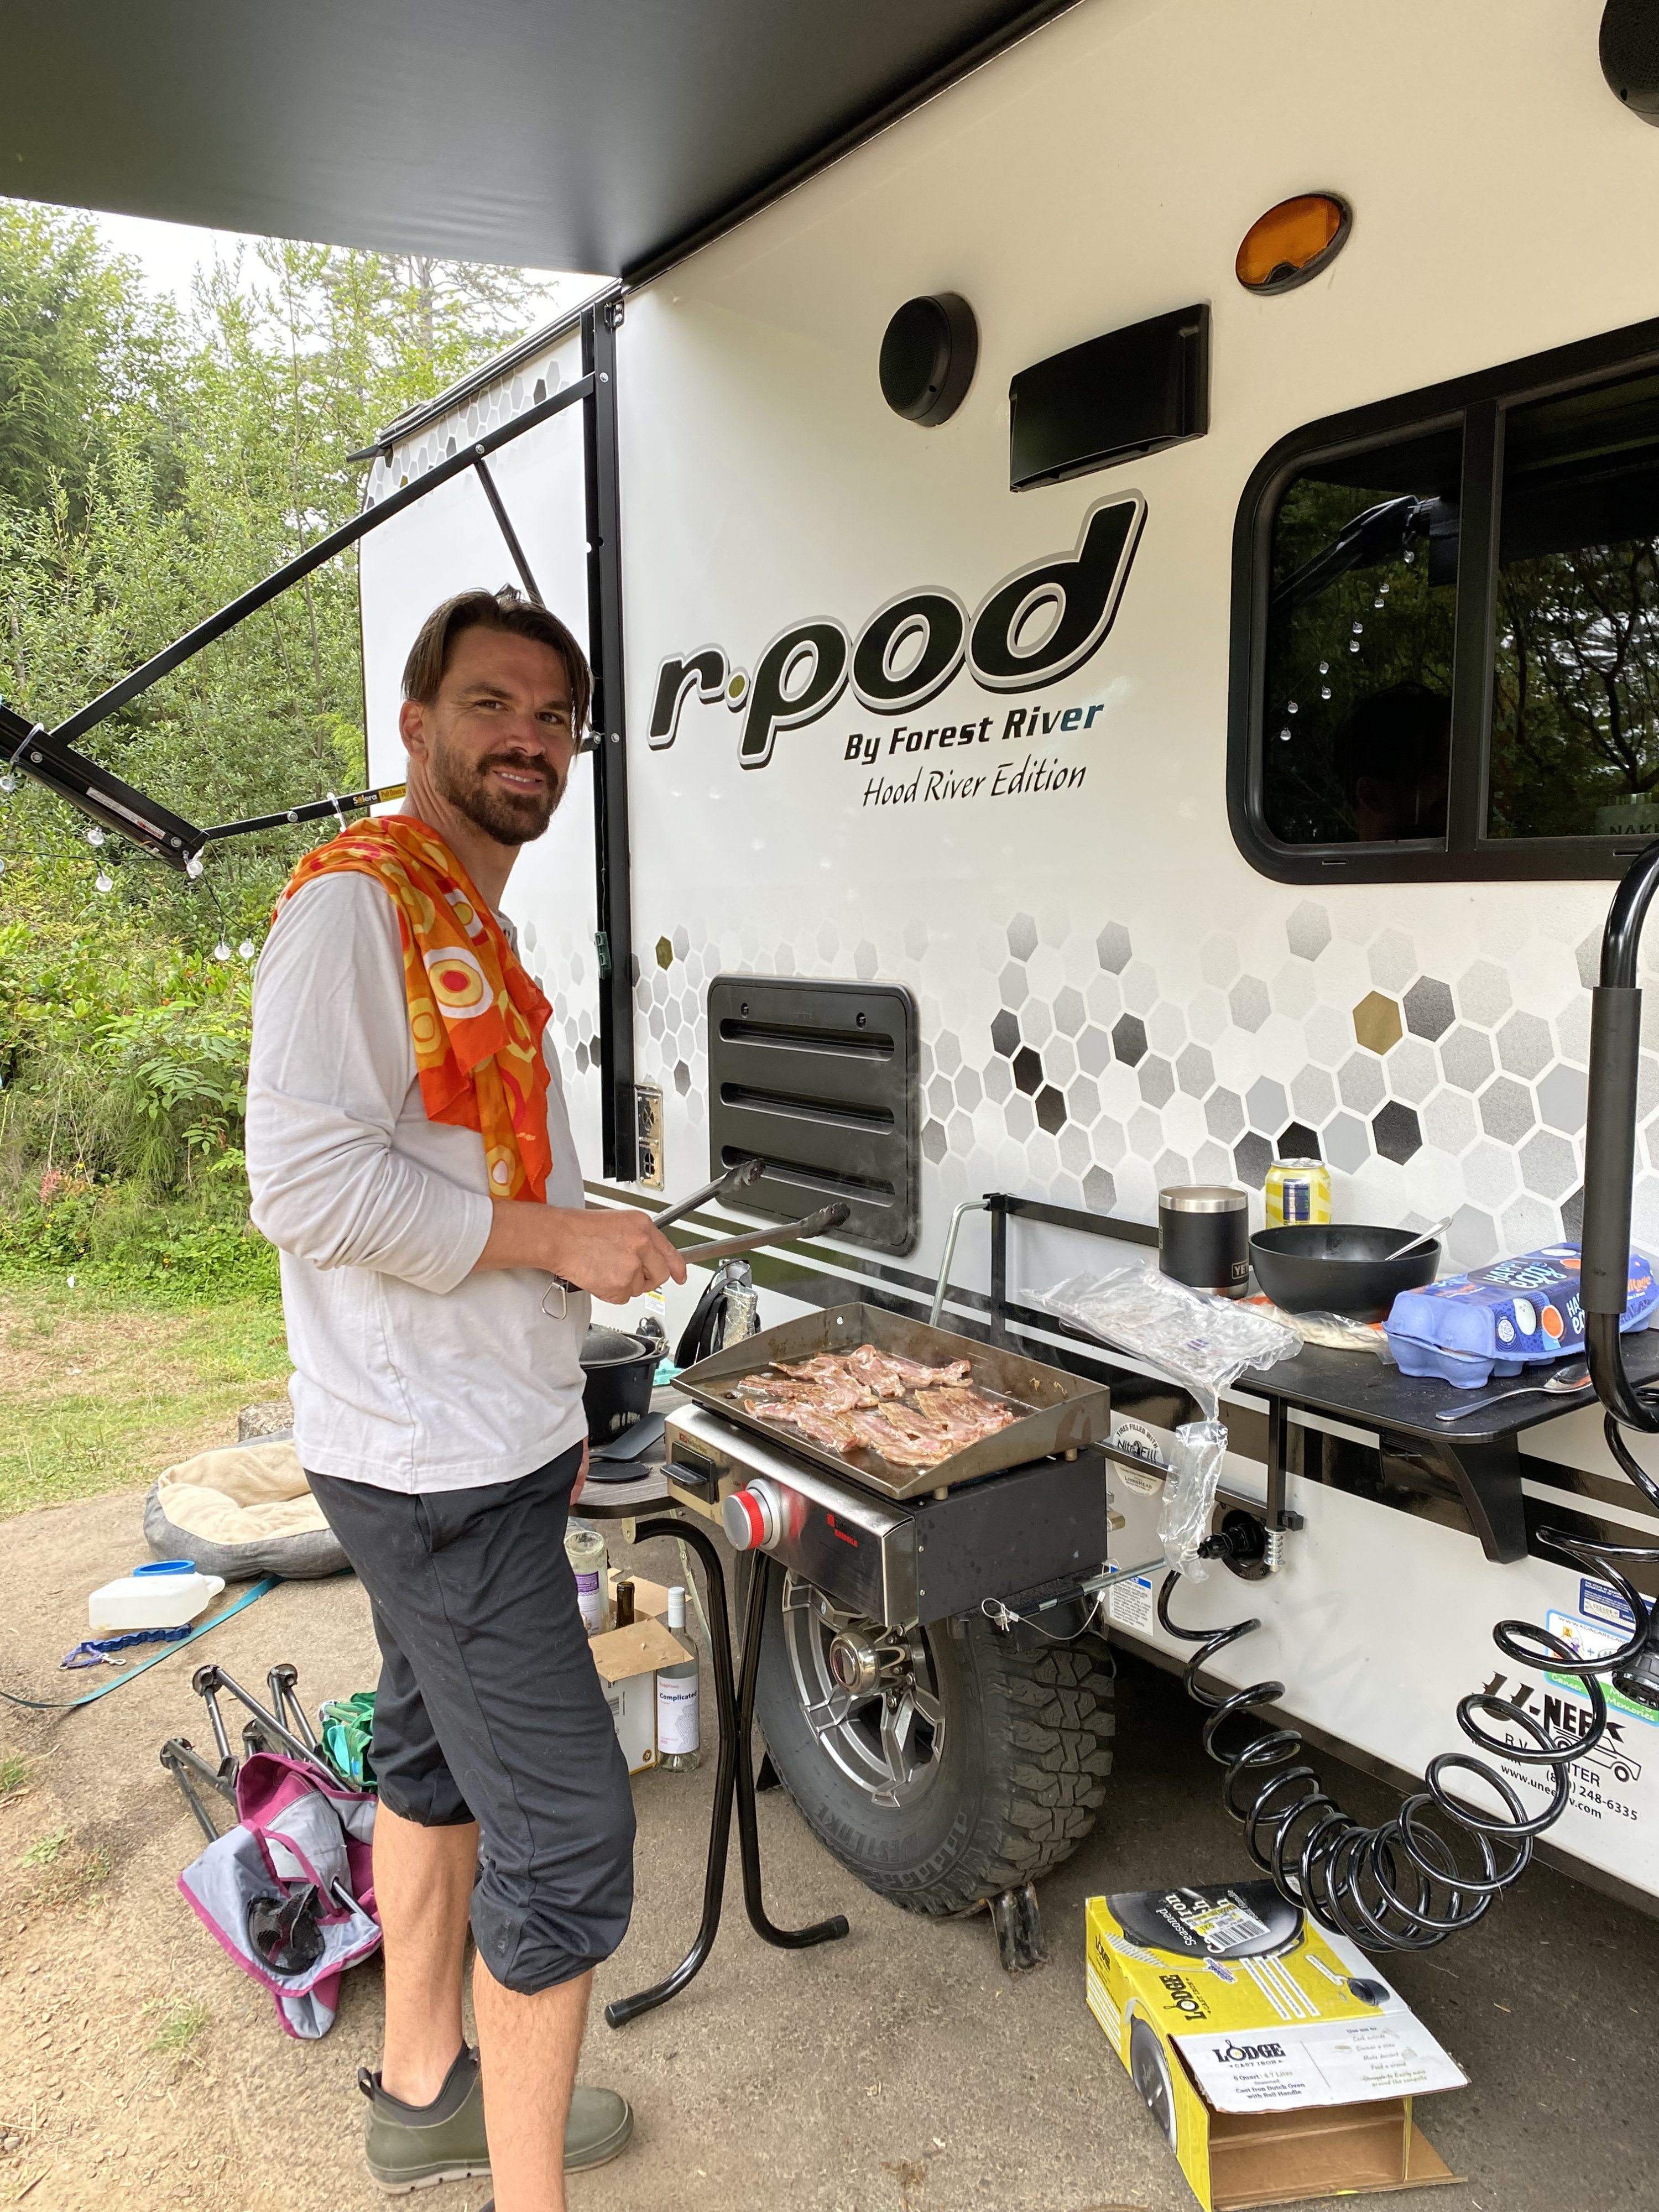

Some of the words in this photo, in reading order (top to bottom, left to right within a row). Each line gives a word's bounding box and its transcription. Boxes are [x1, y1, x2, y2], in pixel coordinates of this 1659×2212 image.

[844, 733, 880, 765] By
[888, 716, 993, 756] Forest
[1002, 700, 1105, 740] River
[862, 765, 925, 807] Hood
[925, 769, 987, 802] River
[992, 753, 1087, 797] Edition
[352, 794, 378, 805] Solera
[1483, 1259, 1528, 1284] HAPPY
[1117, 1424, 1129, 1437] TIRES
[1129, 1423, 1146, 1434] FILLED
[1146, 1432, 1159, 1449] WITH
[1124, 1475, 1152, 1489] LIONSHEAD
[1551, 1673, 1583, 1692] Cancer
[659, 1690, 697, 1702] Complicated
[1605, 1695, 1655, 1722] Memories
[1579, 1786, 1639, 1821] 248-6335
[1156, 1907, 1197, 1947] Seasoned
[1159, 1974, 1207, 2021] LODGE
[1212, 2039, 1286, 2063] LODGE
